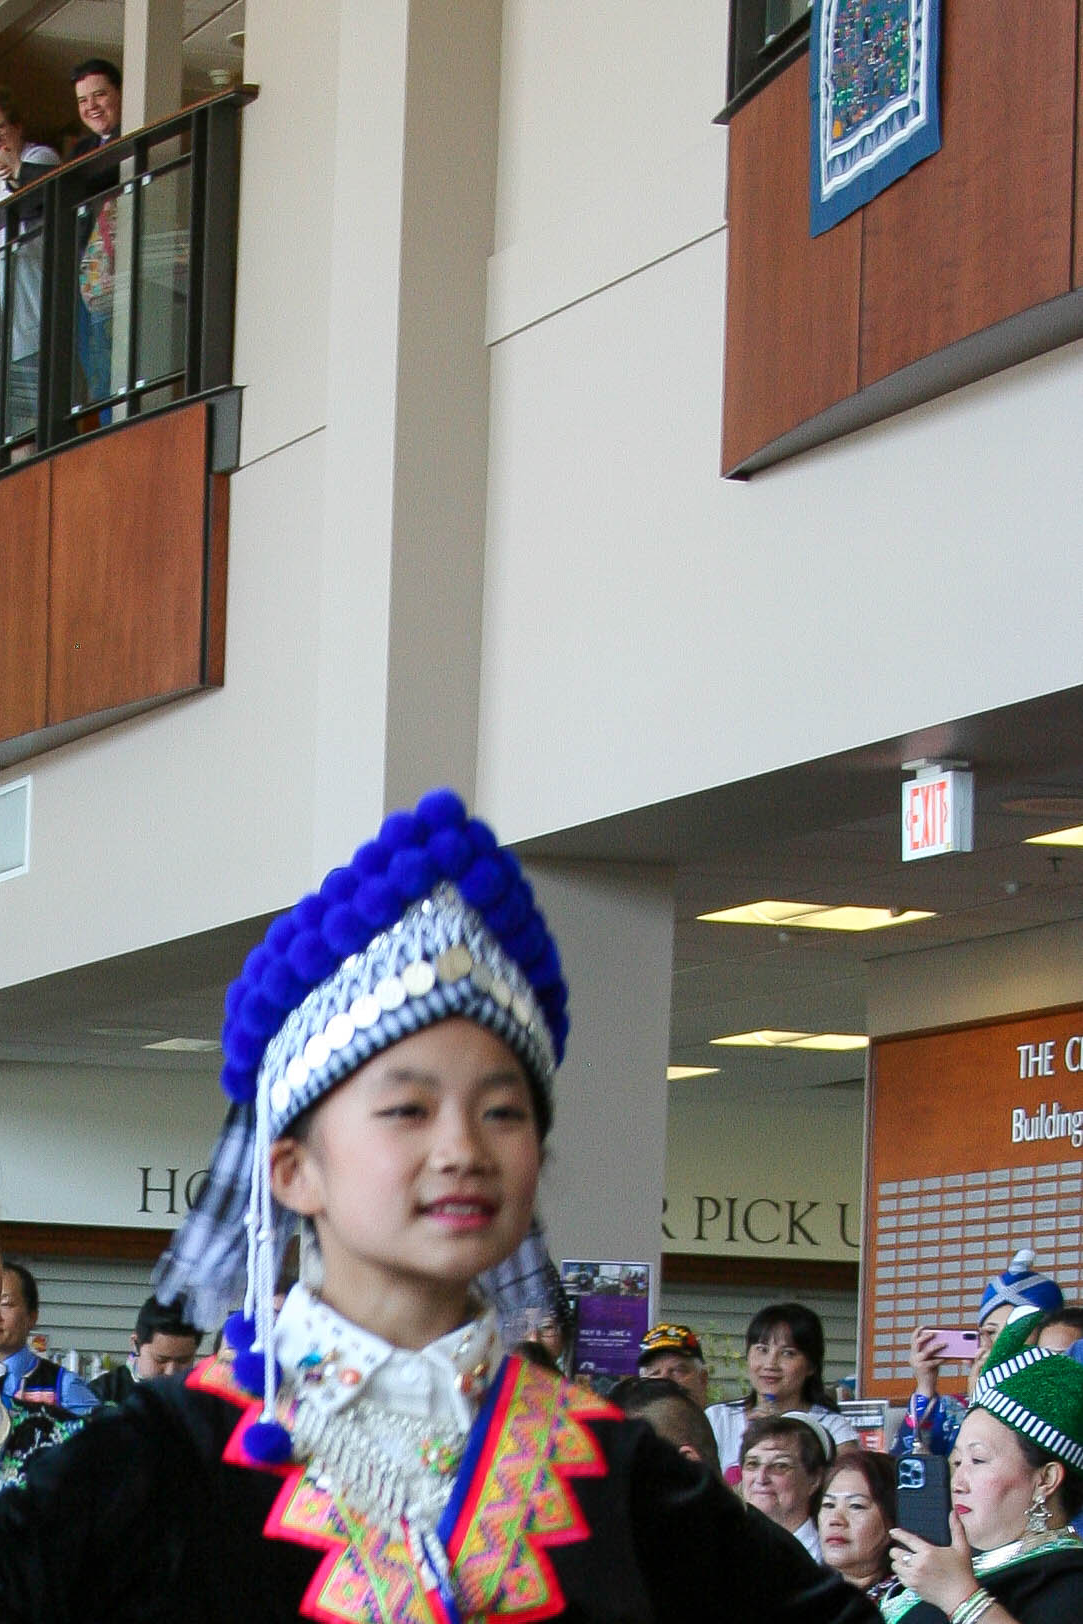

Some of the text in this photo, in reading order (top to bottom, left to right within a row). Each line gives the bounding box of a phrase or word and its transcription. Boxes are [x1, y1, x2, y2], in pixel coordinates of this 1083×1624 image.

[910, 781, 947, 851] EXIT
[1016, 1040, 1056, 1080] THE
[693, 1196, 821, 1246] PICK
